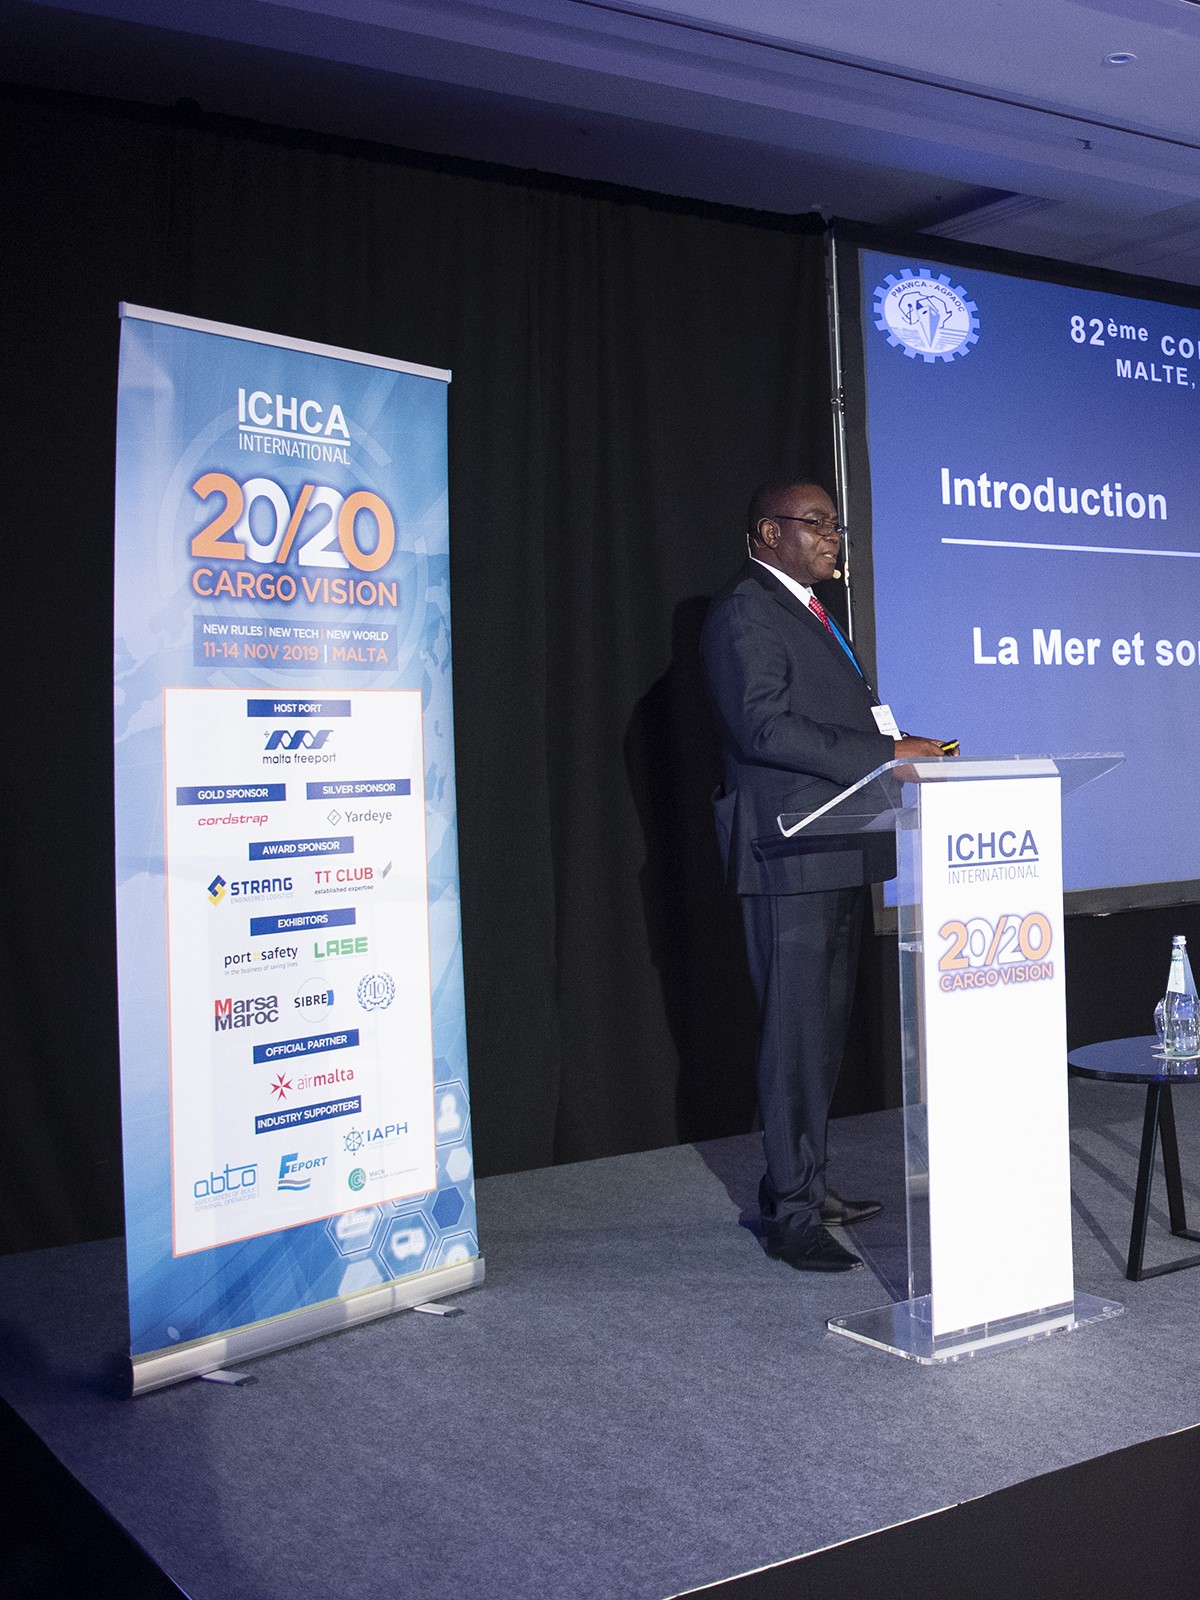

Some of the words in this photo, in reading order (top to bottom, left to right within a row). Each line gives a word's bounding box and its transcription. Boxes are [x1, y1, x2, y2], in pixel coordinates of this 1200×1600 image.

[891, 280, 927, 297] PMAWCA
[934, 285, 965, 313] AGPAOC
[1070, 315, 1148, 346] 82ème
[1116, 358, 1196, 389] MALTE,
[238, 388, 350, 438] ICHCA
[239, 433, 351, 465] INTERNATIONAL
[941, 467, 1167, 520] Introduction
[191, 473, 395, 572] 20/20
[192, 569, 296, 601] CARGO
[301, 577, 397, 606] VISION
[203, 624, 228, 635] NEW
[230, 624, 263, 637] RULES
[269, 626, 291, 638] NEW
[293, 627, 319, 639] TECH
[326, 629, 351, 640] NEW
[353, 629, 389, 641] WORLD
[203, 642, 239, 659] 11-14
[244, 643, 279, 660] NOV
[282, 645, 319, 661] 2019
[332, 646, 388, 663] MALTA
[973, 627, 1019, 665] La
[1032, 628, 1101, 666] Mer
[1112, 632, 1145, 666] et
[274, 703, 297, 713] HOST
[299, 704, 322, 713] PORT
[262, 754, 291, 764] malta
[294, 753, 336, 765] freeport
[198, 790, 224, 800] GOLD
[226, 788, 268, 799] SPONSOR
[323, 785, 353, 795] SILVER
[355, 783, 396, 794] SPONSOR
[198, 813, 268, 826] cordstrap
[345, 810, 392, 823] Yardeye
[262, 844, 296, 855] AWARD
[297, 841, 340, 852] SPONSOR
[948, 830, 1039, 861] ICHCA
[314, 870, 331, 884] TT
[336, 867, 373, 883] CLUB
[949, 865, 1039, 884] INTERNATIONAL
[231, 877, 293, 896] STRANG
[315, 886, 347, 895] established
[348, 884, 373, 893] expertise
[277, 914, 328, 928] EXHIBITORS
[314, 937, 368, 958] LASE
[939, 912, 1052, 971] 20/20
[224, 951, 251, 968] port
[261, 947, 298, 961] safety
[241, 965, 262, 974] business
[940, 970, 999, 991] CARGO
[1000, 963, 1053, 984] VISION
[294, 993, 328, 1008] SIBRE
[369, 981, 385, 999] ILO
[214, 995, 278, 1016] Marsa
[215, 1009, 279, 1032] Maroc
[265, 1042, 306, 1057] OFFICIAL
[307, 1035, 347, 1050] PARTNER
[297, 1068, 354, 1090] airmalta
[257, 1111, 303, 1129] INDUSTRY
[303, 1100, 360, 1120] SUPPORTERS
[367, 1122, 407, 1142] IAPH
[194, 1163, 258, 1198] abto
